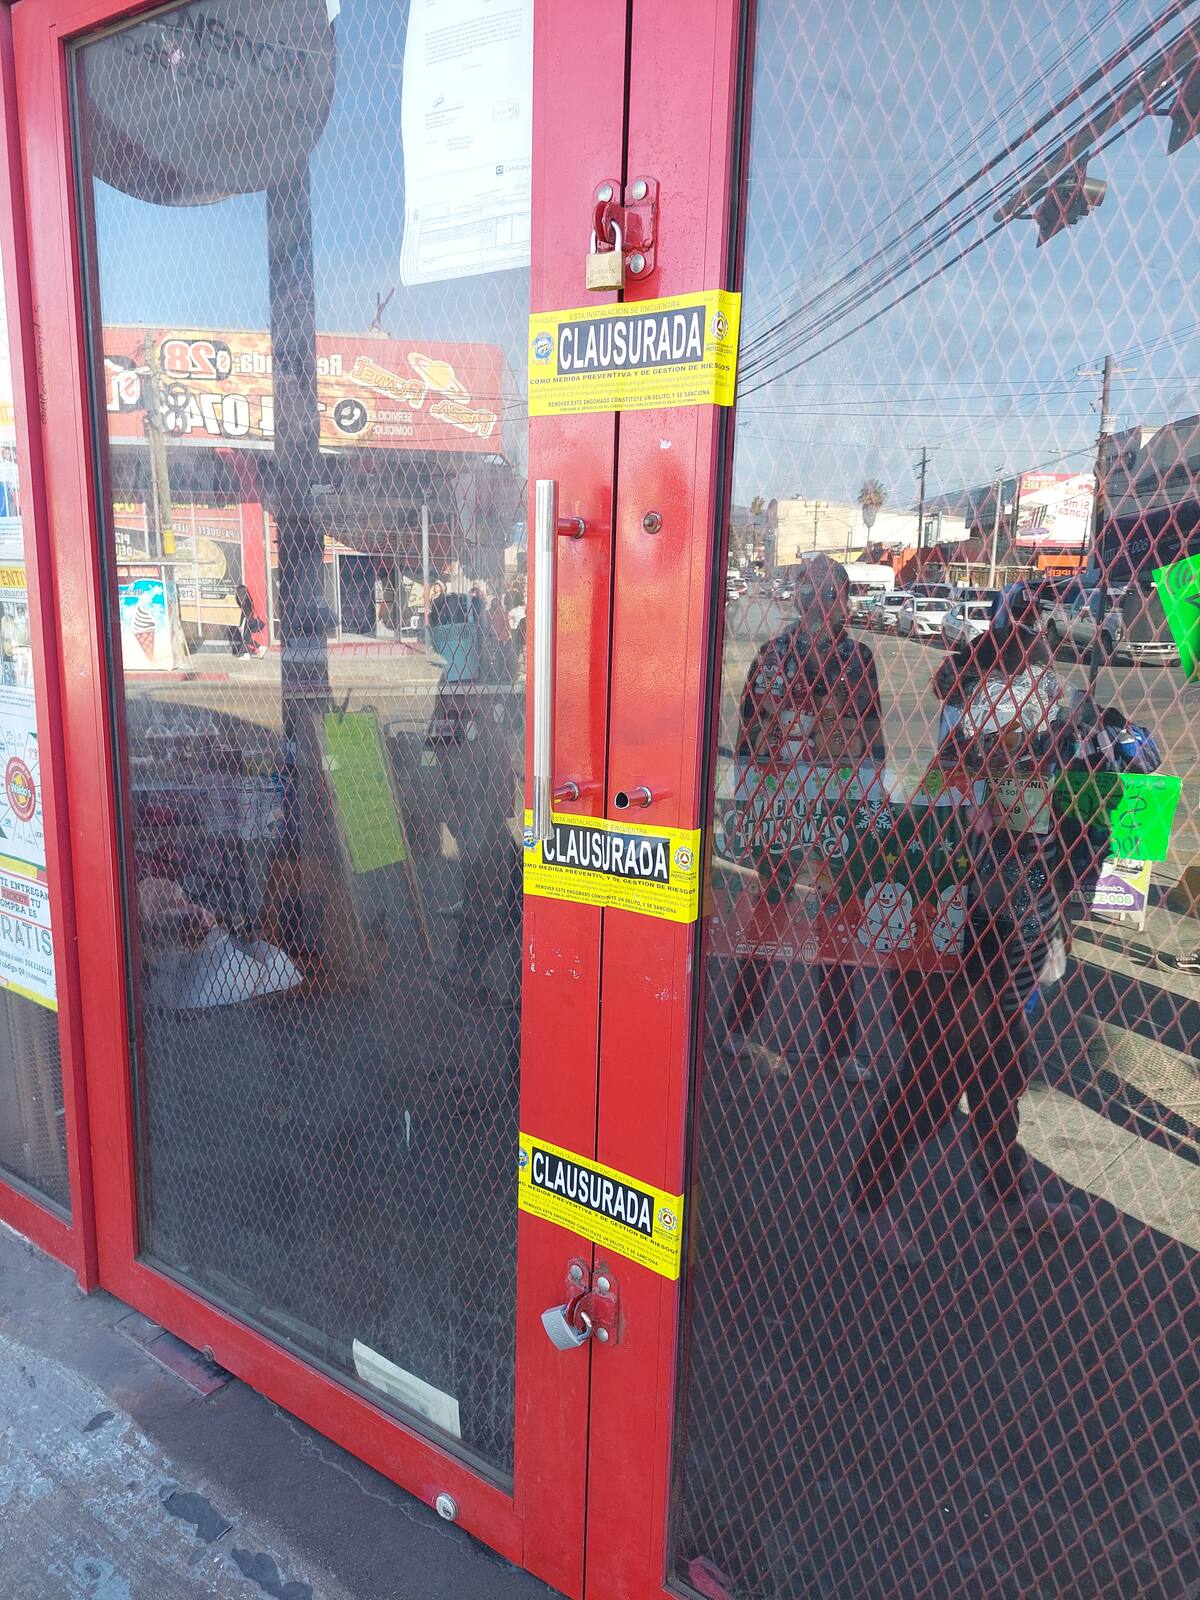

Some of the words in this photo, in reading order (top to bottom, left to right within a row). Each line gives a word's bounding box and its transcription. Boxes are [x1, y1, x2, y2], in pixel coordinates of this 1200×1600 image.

[569, 311, 585, 321] ESTA
[586, 307, 628, 319] INSTALACION
[630, 306, 638, 315] SE
[640, 300, 680, 313] ENCUENTRA
[558, 312, 702, 369] CLAUSURADA
[529, 377, 551, 385] COMO
[553, 375, 581, 383] MEDIDA
[582, 371, 632, 380] PREVENTIVA
[652, 365, 686, 374] GESTION
[543, 828, 668, 880] CLAUSURADA
[538, 864, 564, 873] MEDIDA
[623, 878, 654, 888] GESTION
[28, 907, 37, 919] ES
[528, 1184, 552, 1198] MEDIDA
[552, 1195, 593, 1216] PREVENTIVA
[609, 1220, 639, 1237] GESTION
[533, 1152, 651, 1232] CLAUSURADA
